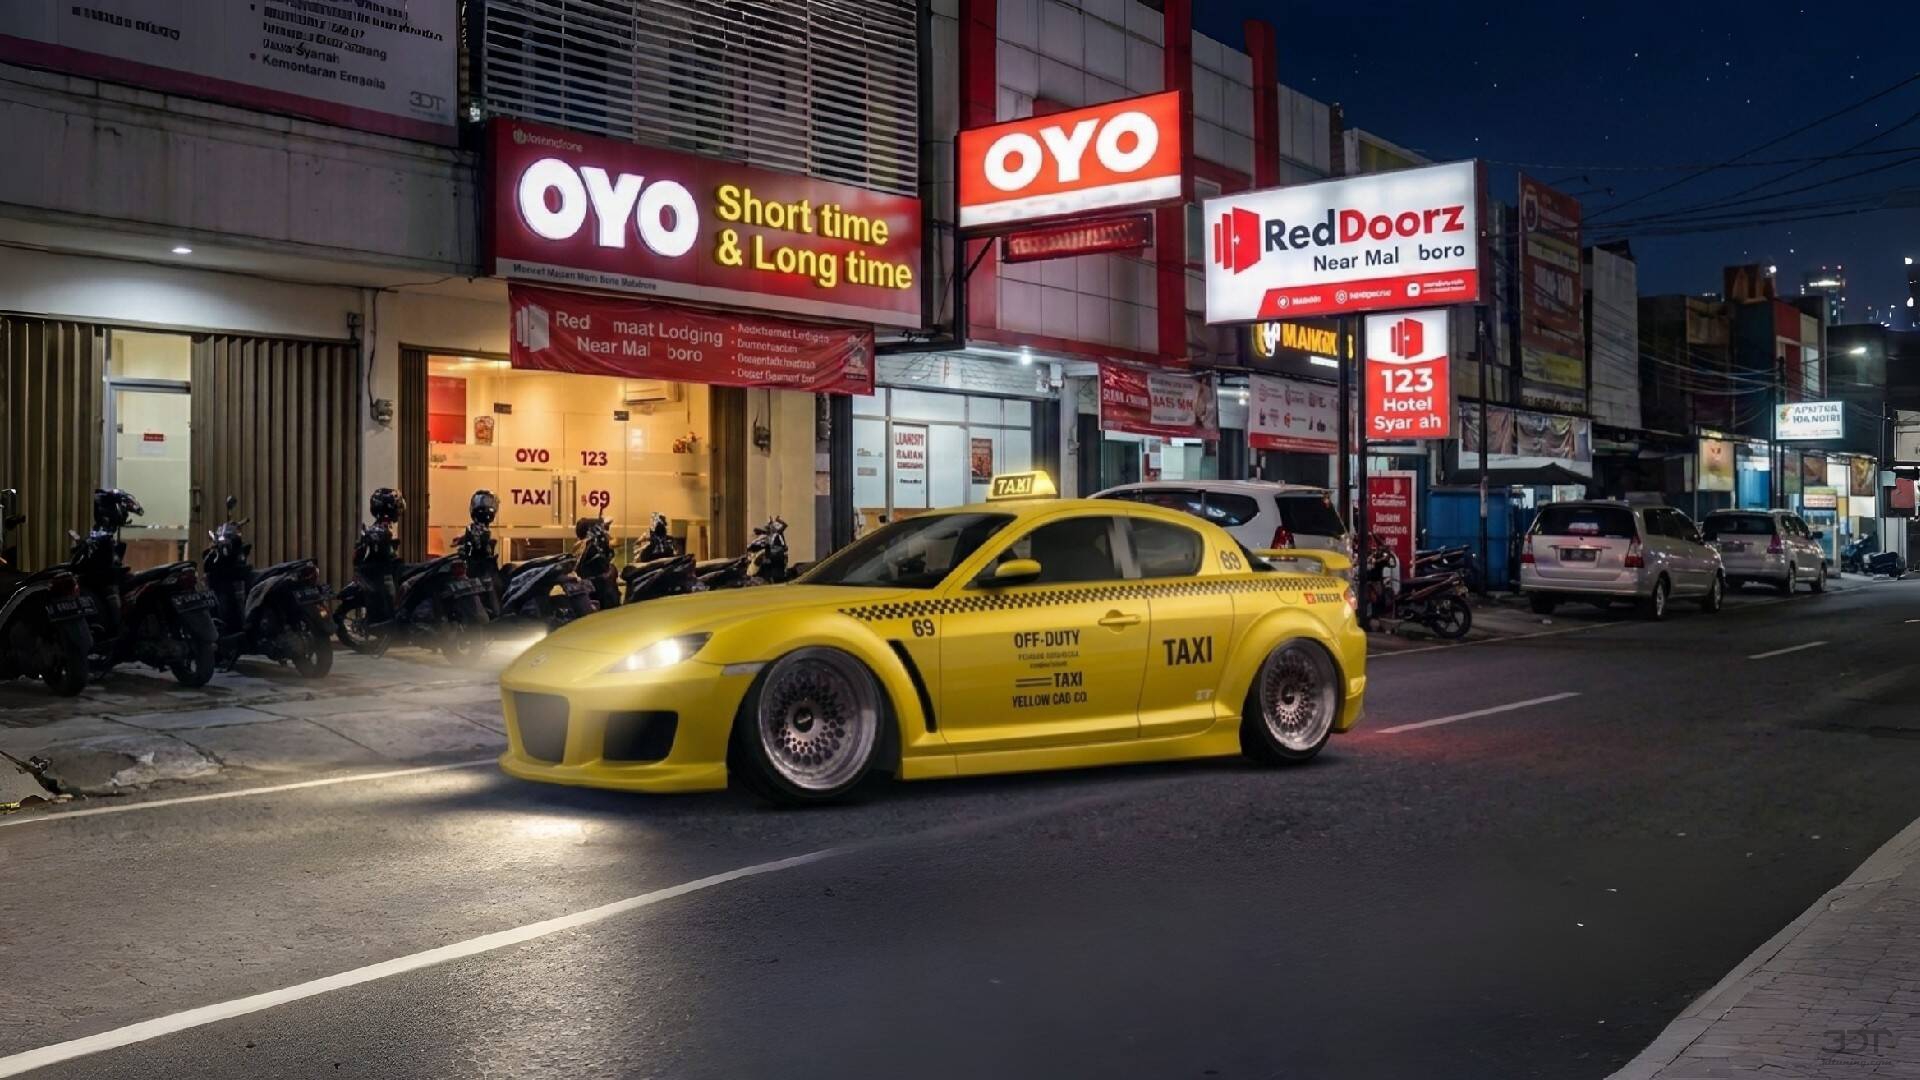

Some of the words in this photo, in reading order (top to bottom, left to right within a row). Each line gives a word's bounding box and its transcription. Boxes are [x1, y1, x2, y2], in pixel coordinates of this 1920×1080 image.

[984, 111, 1159, 192] OYO
[518, 157, 699, 258] OYO
[718, 184, 814, 234] Short
[819, 203, 889, 245] time
[1265, 205, 1465, 252] RedDoorz
[717, 229, 743, 266] &
[754, 234, 838, 288] Long
[845, 250, 912, 289] time
[1313, 254, 1359, 272] Near
[1418, 244, 1465, 262] boro
[556, 311, 592, 330] Red
[659, 322, 724, 348] Lodging
[577, 336, 618, 353] Near
[1381, 368, 1434, 393] 123
[1383, 396, 1433, 412] Hotel
[1374, 415, 1414, 434] Syar
[1419, 414, 1442, 428] ah
[516, 448, 550, 463] OYO
[580, 451, 608, 466] 123
[511, 489, 552, 505] TAXI
[588, 490, 610, 509] 69
[911, 618, 936, 637] 69
[1013, 629, 1080, 649] OFF-DUTY
[1163, 636, 1213, 666] TAXI
[1053, 671, 1083, 688] TAXI
[1012, 694, 1051, 708] YELLOW
